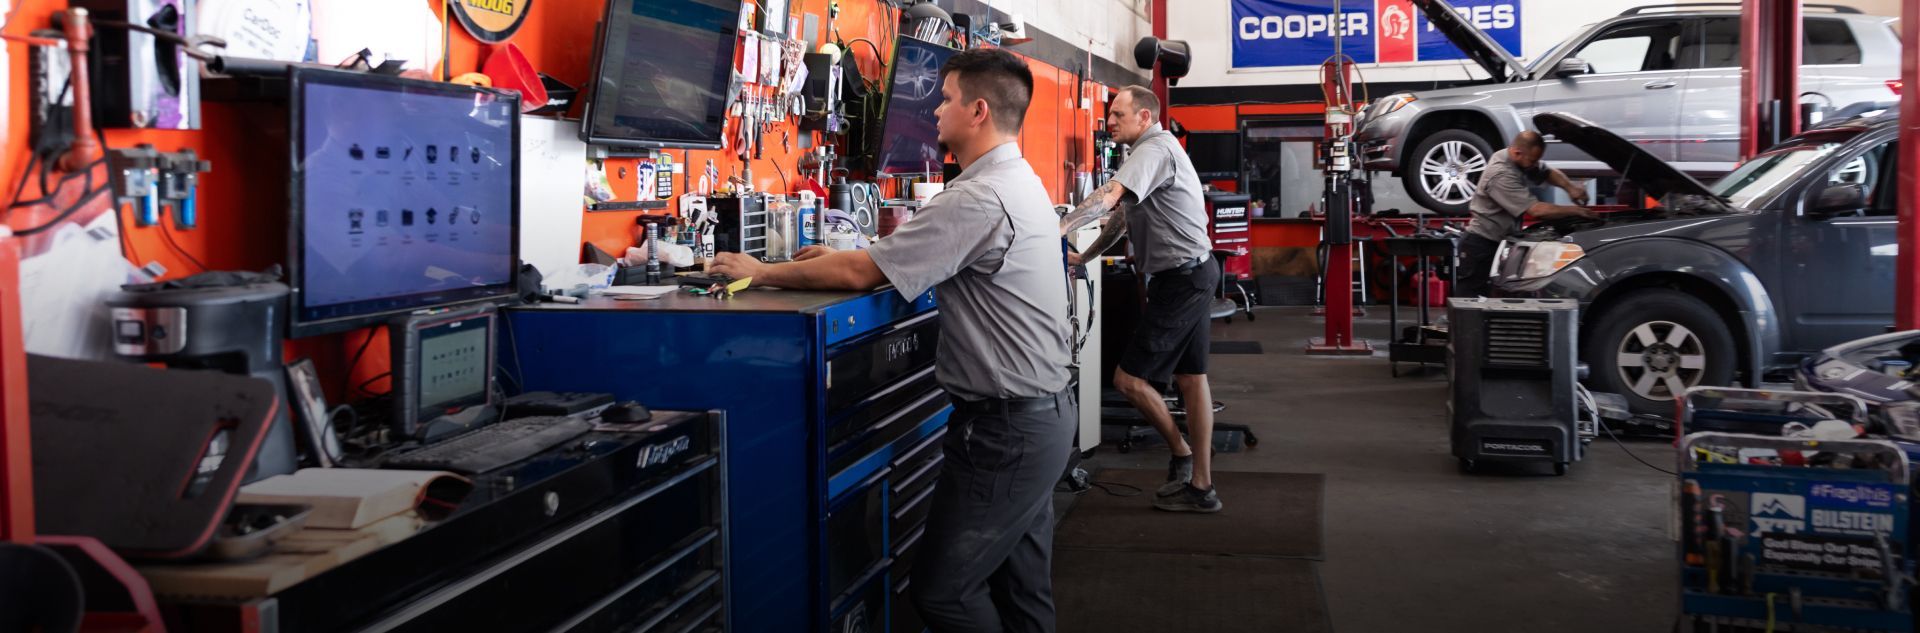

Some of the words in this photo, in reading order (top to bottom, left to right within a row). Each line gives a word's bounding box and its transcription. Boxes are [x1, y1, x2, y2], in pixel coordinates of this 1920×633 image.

[1239, 12, 1368, 40] COOPER
[1216, 207, 1245, 215] HUNTER
[1483, 442, 1545, 451] PORTACOOL
[1811, 509, 1894, 532] BILSTEIN
[1824, 543, 1848, 554] Our
[1823, 555, 1847, 565] Our
